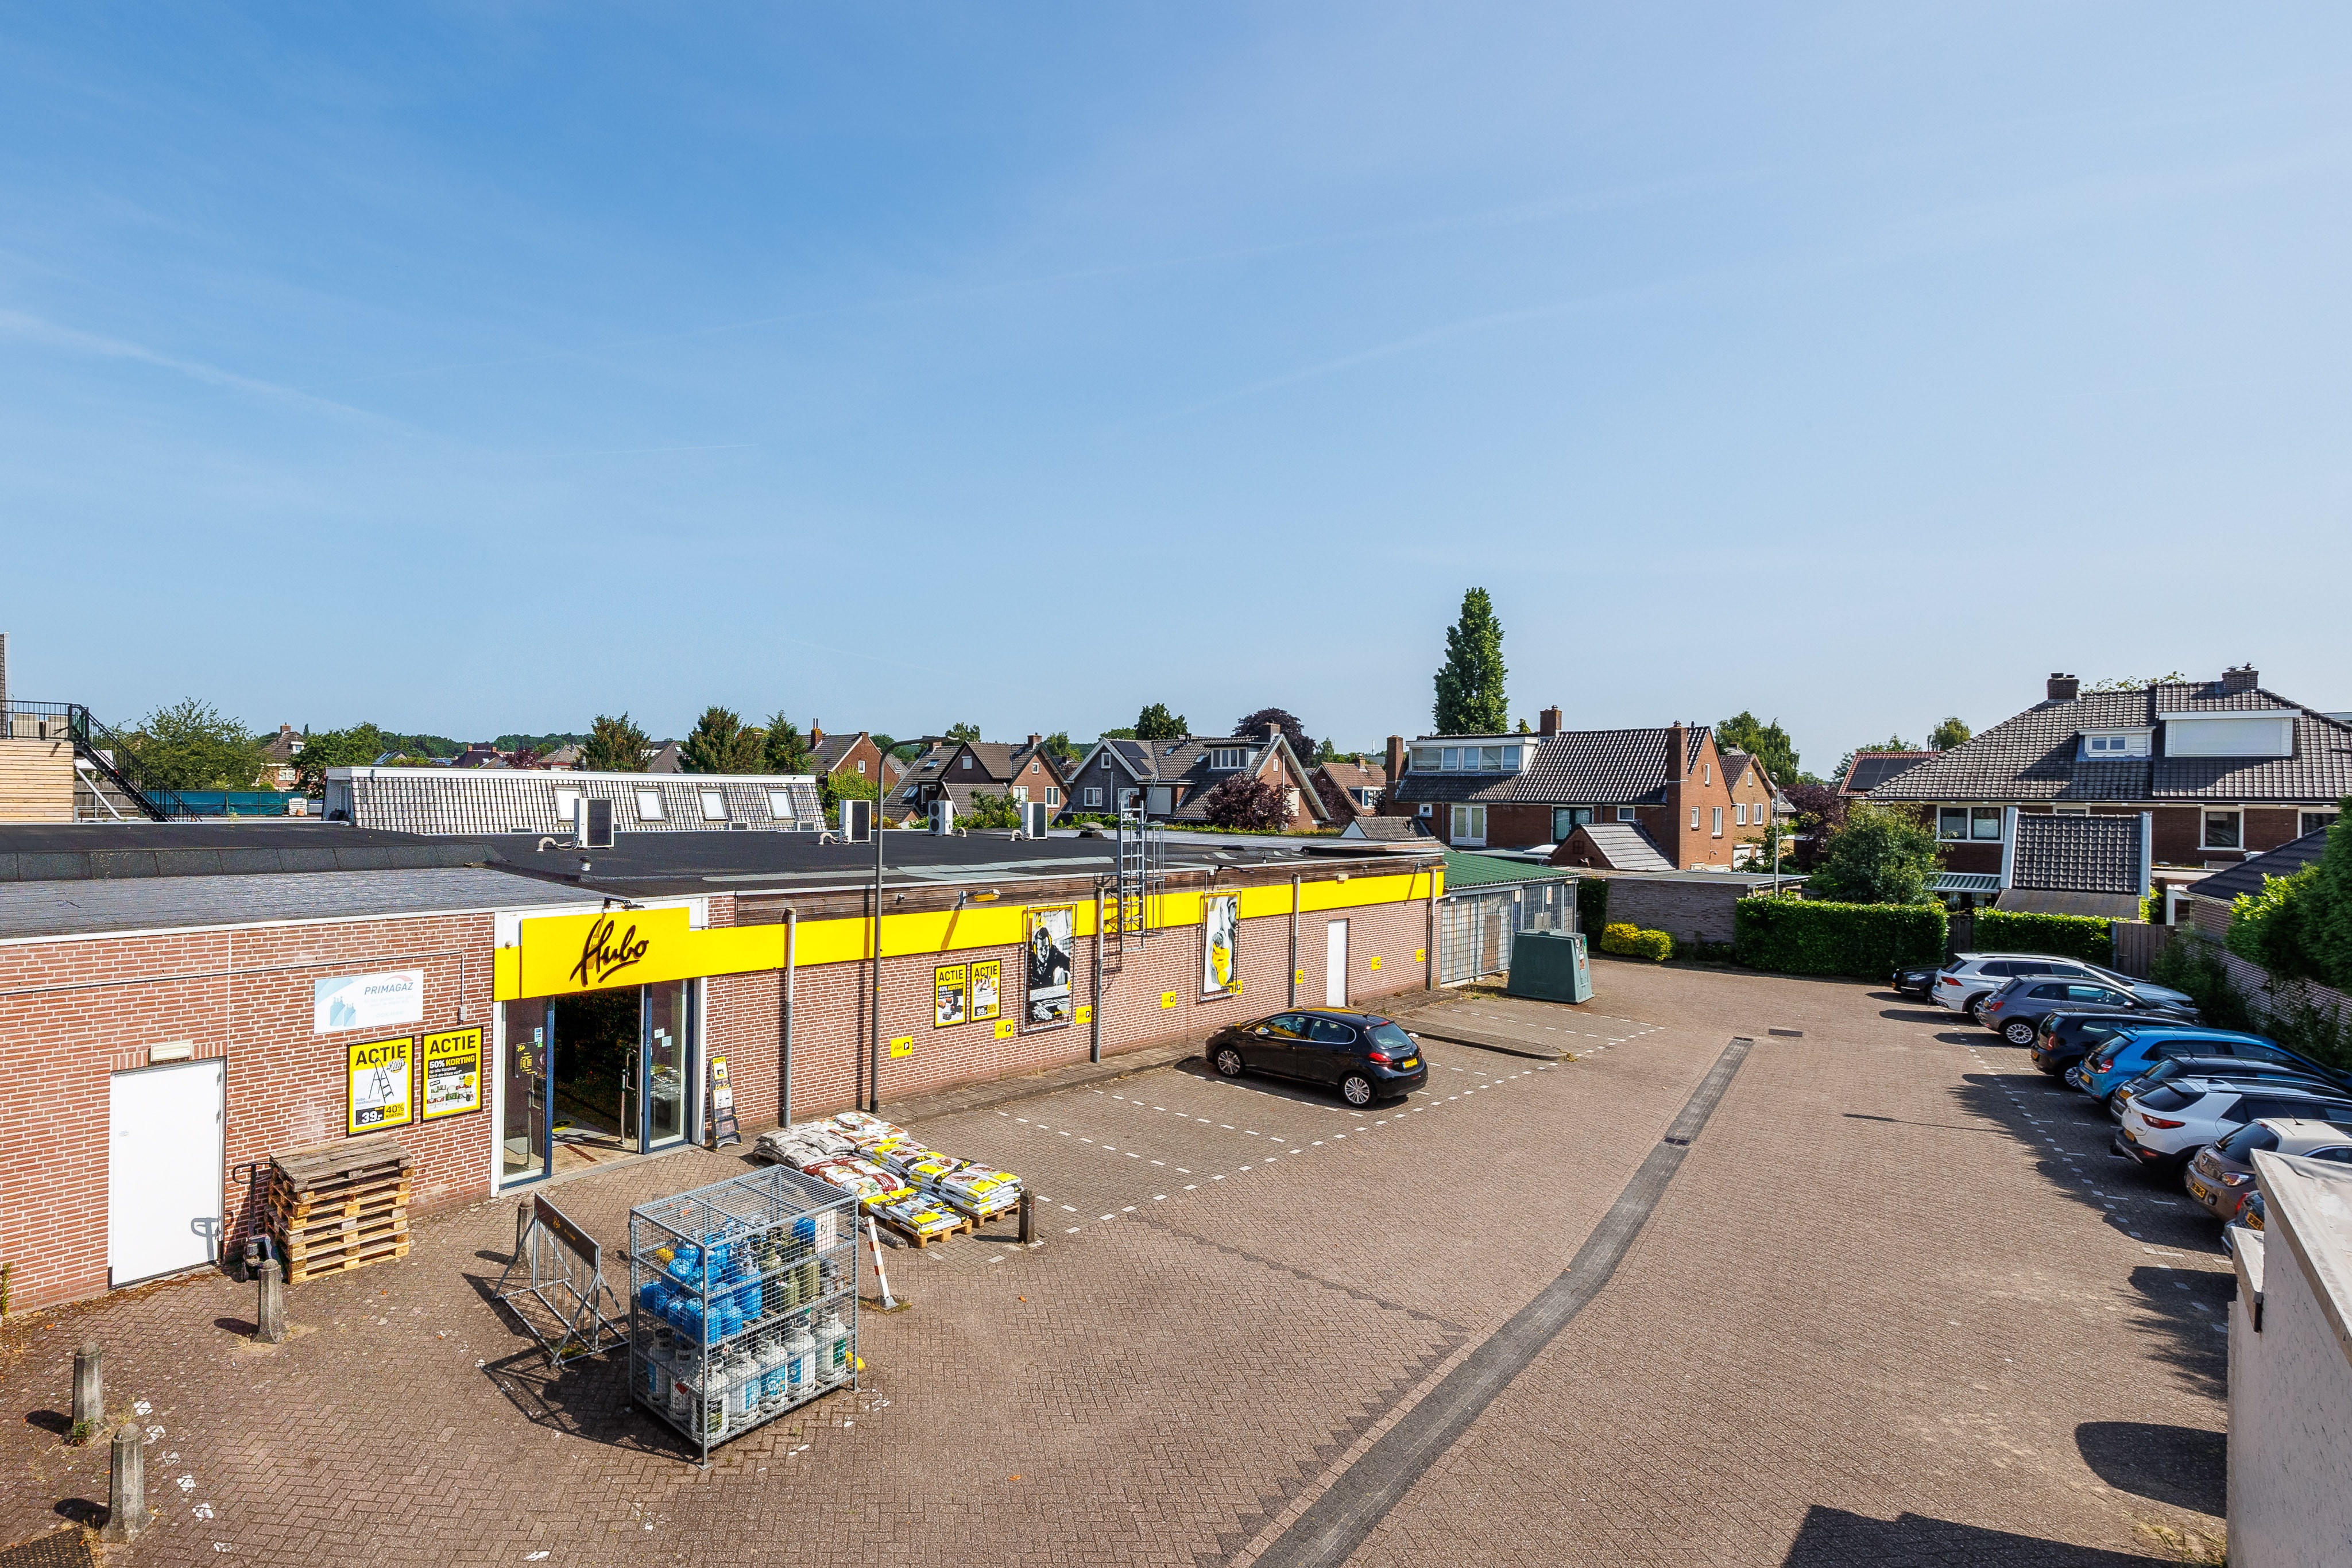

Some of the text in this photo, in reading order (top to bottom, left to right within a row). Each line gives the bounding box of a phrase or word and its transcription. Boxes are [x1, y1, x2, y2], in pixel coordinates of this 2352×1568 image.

[570, 919, 649, 987] Hubo
[939, 969, 964, 982] ACTIE
[974, 965, 997, 978] ACTIE
[364, 982, 413, 995] PRIMAGAZ
[430, 1035, 475, 1054] ACTIE
[355, 1044, 406, 1066] ACTIE
[429, 1055, 475, 1068] 50% KORTING
[386, 1104, 404, 1113] 40%
